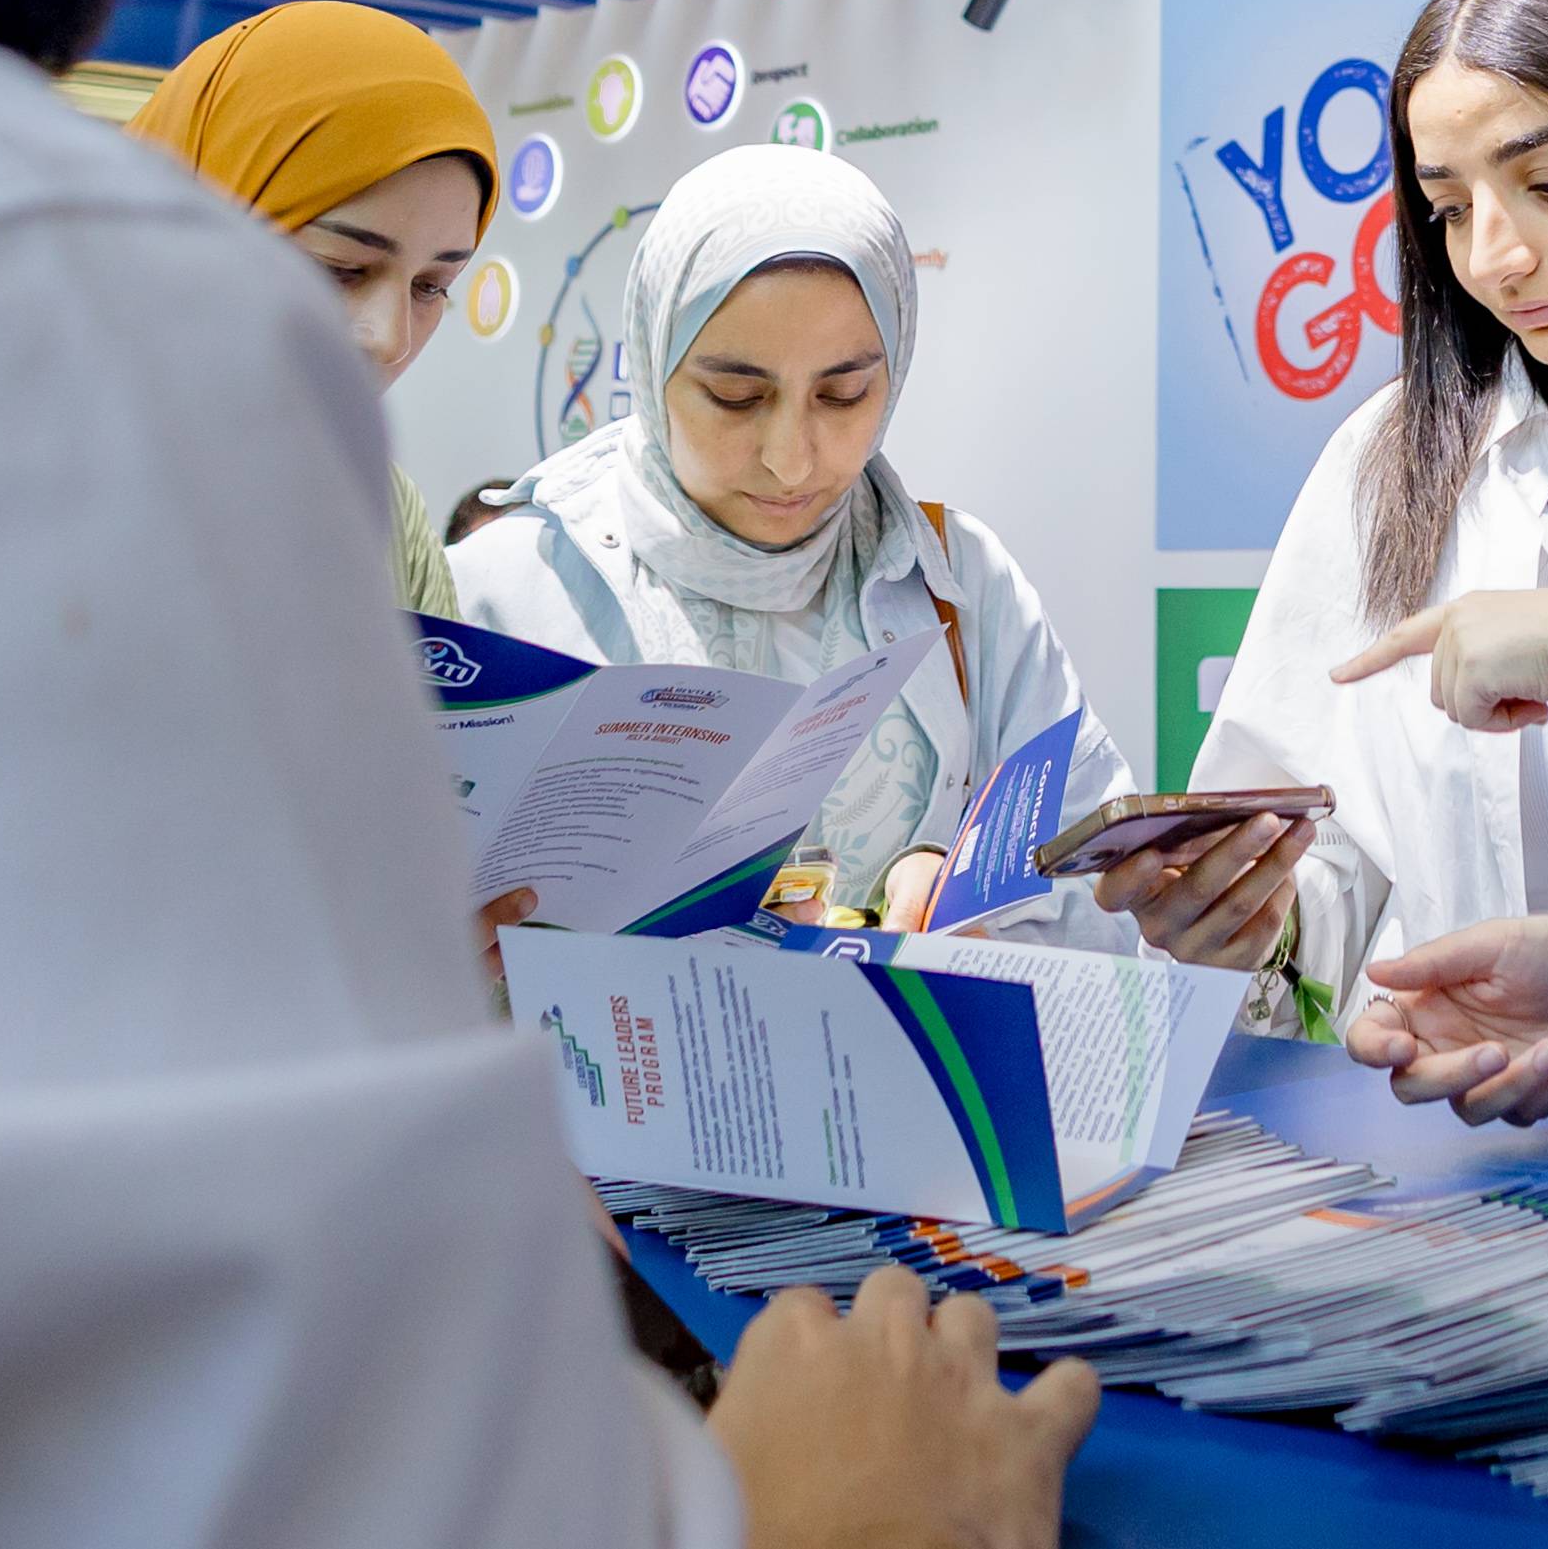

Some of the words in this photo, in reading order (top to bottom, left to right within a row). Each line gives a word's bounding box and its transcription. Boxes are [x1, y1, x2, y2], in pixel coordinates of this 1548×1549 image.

[835, 117, 939, 146] Collaboration
[460, 714, 515, 729] Mission!
[595, 722, 652, 735] SUMMER
[653, 723, 731, 745] INTERNSHIP
[1028, 759, 1052, 840] Contact
[1023, 847, 1037, 879] Us:
[609, 995, 638, 1063] LEADERS
[635, 1016, 665, 1108] PROGRAM
[621, 1065, 646, 1125] FUTURE
